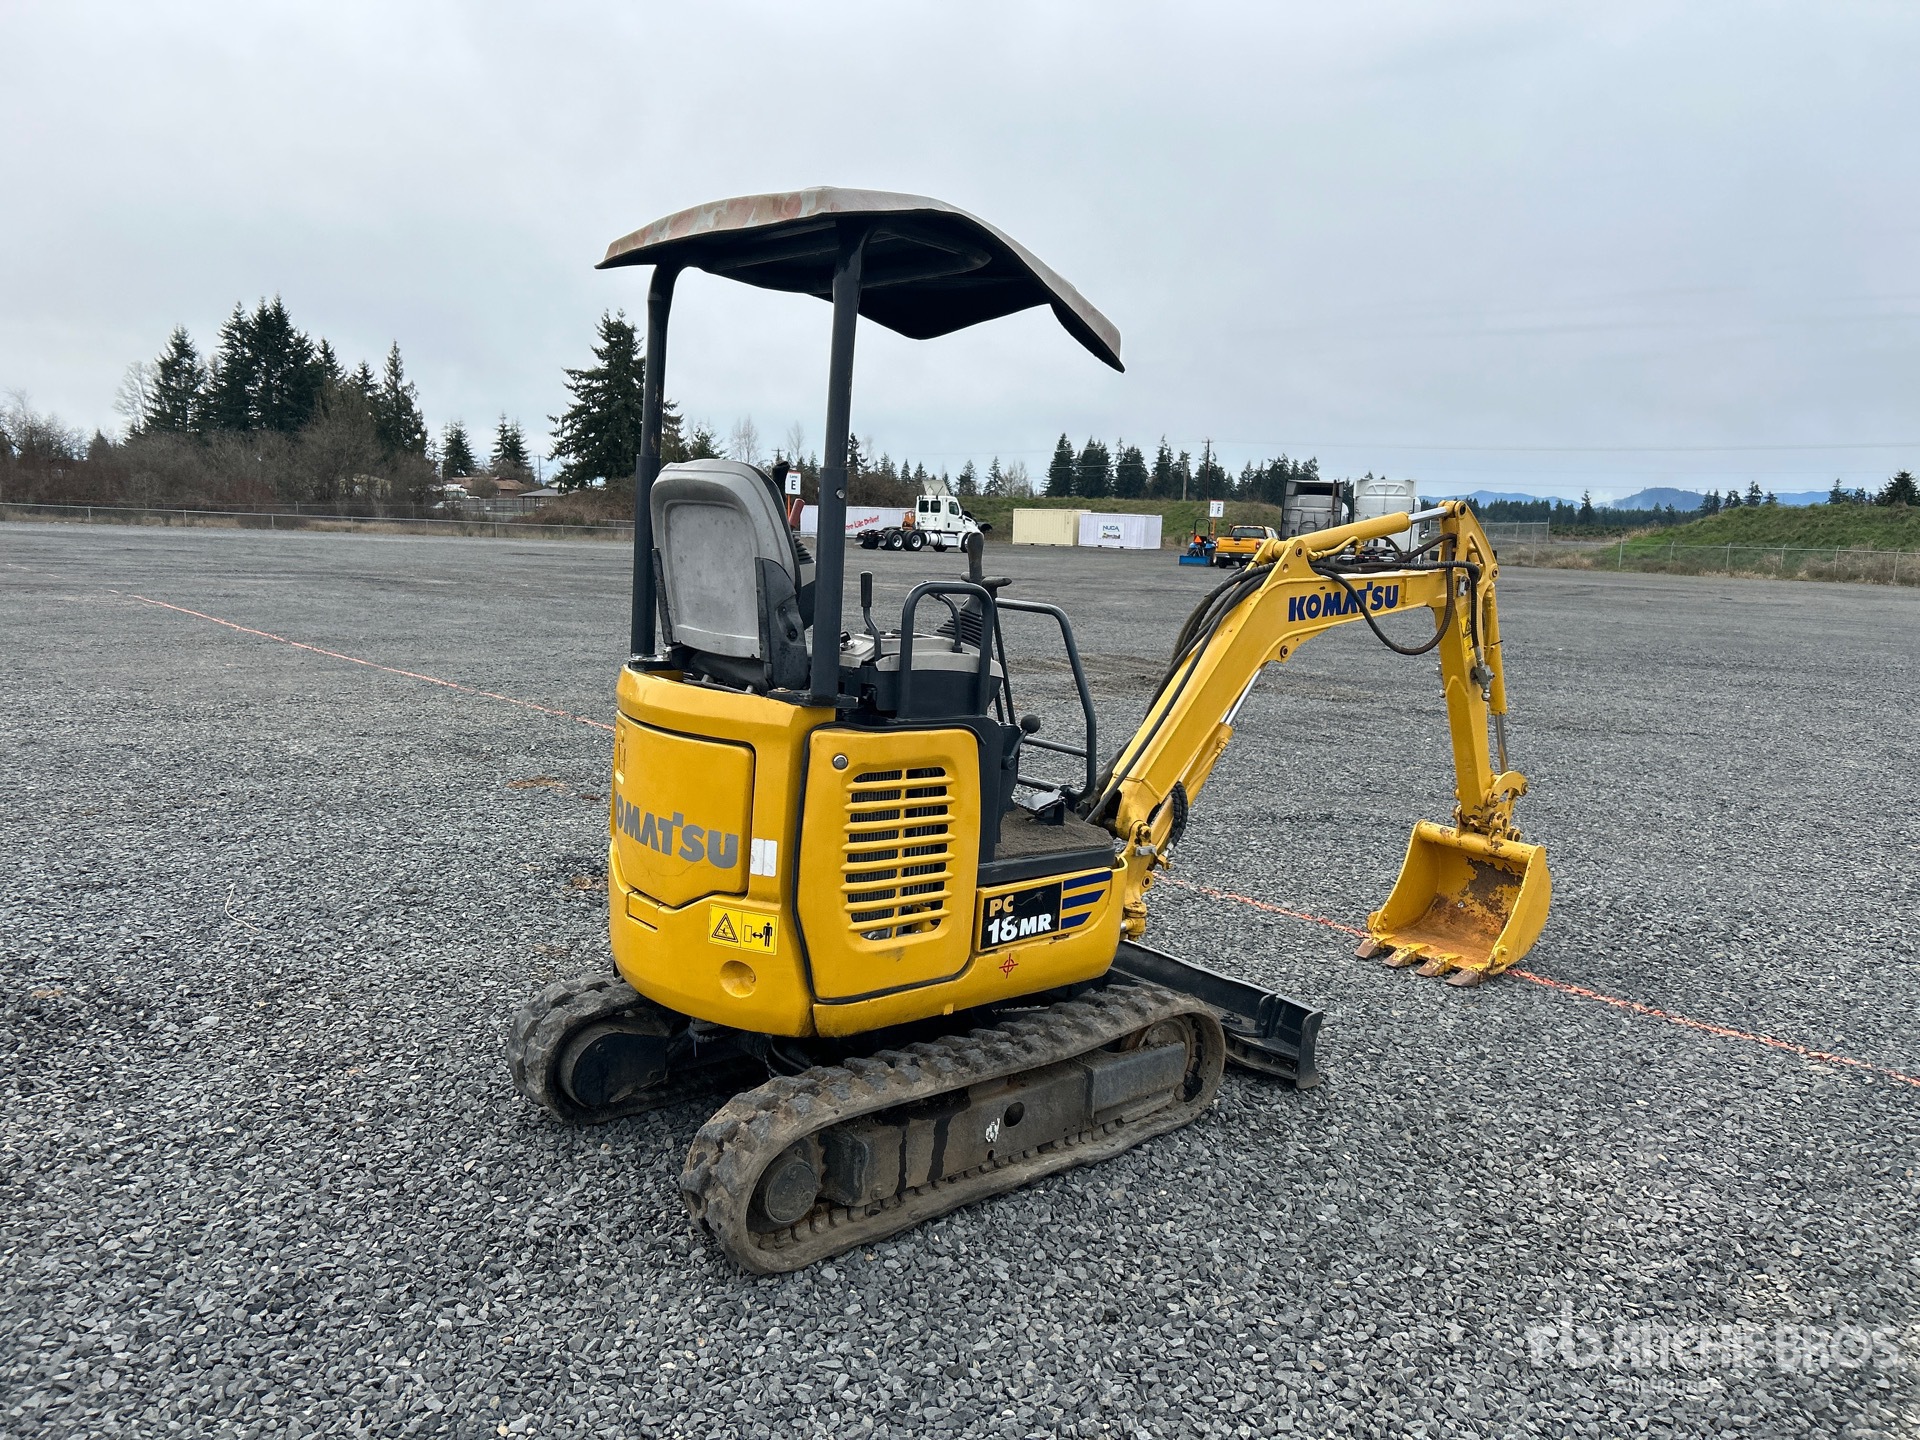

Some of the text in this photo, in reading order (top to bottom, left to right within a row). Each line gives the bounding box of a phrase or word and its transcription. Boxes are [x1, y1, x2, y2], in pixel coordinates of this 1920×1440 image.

[791, 480, 796, 490] E
[1288, 581, 1399, 622] KOMATSU
[616, 791, 739, 869] OMATSU
[989, 895, 1014, 917] PC
